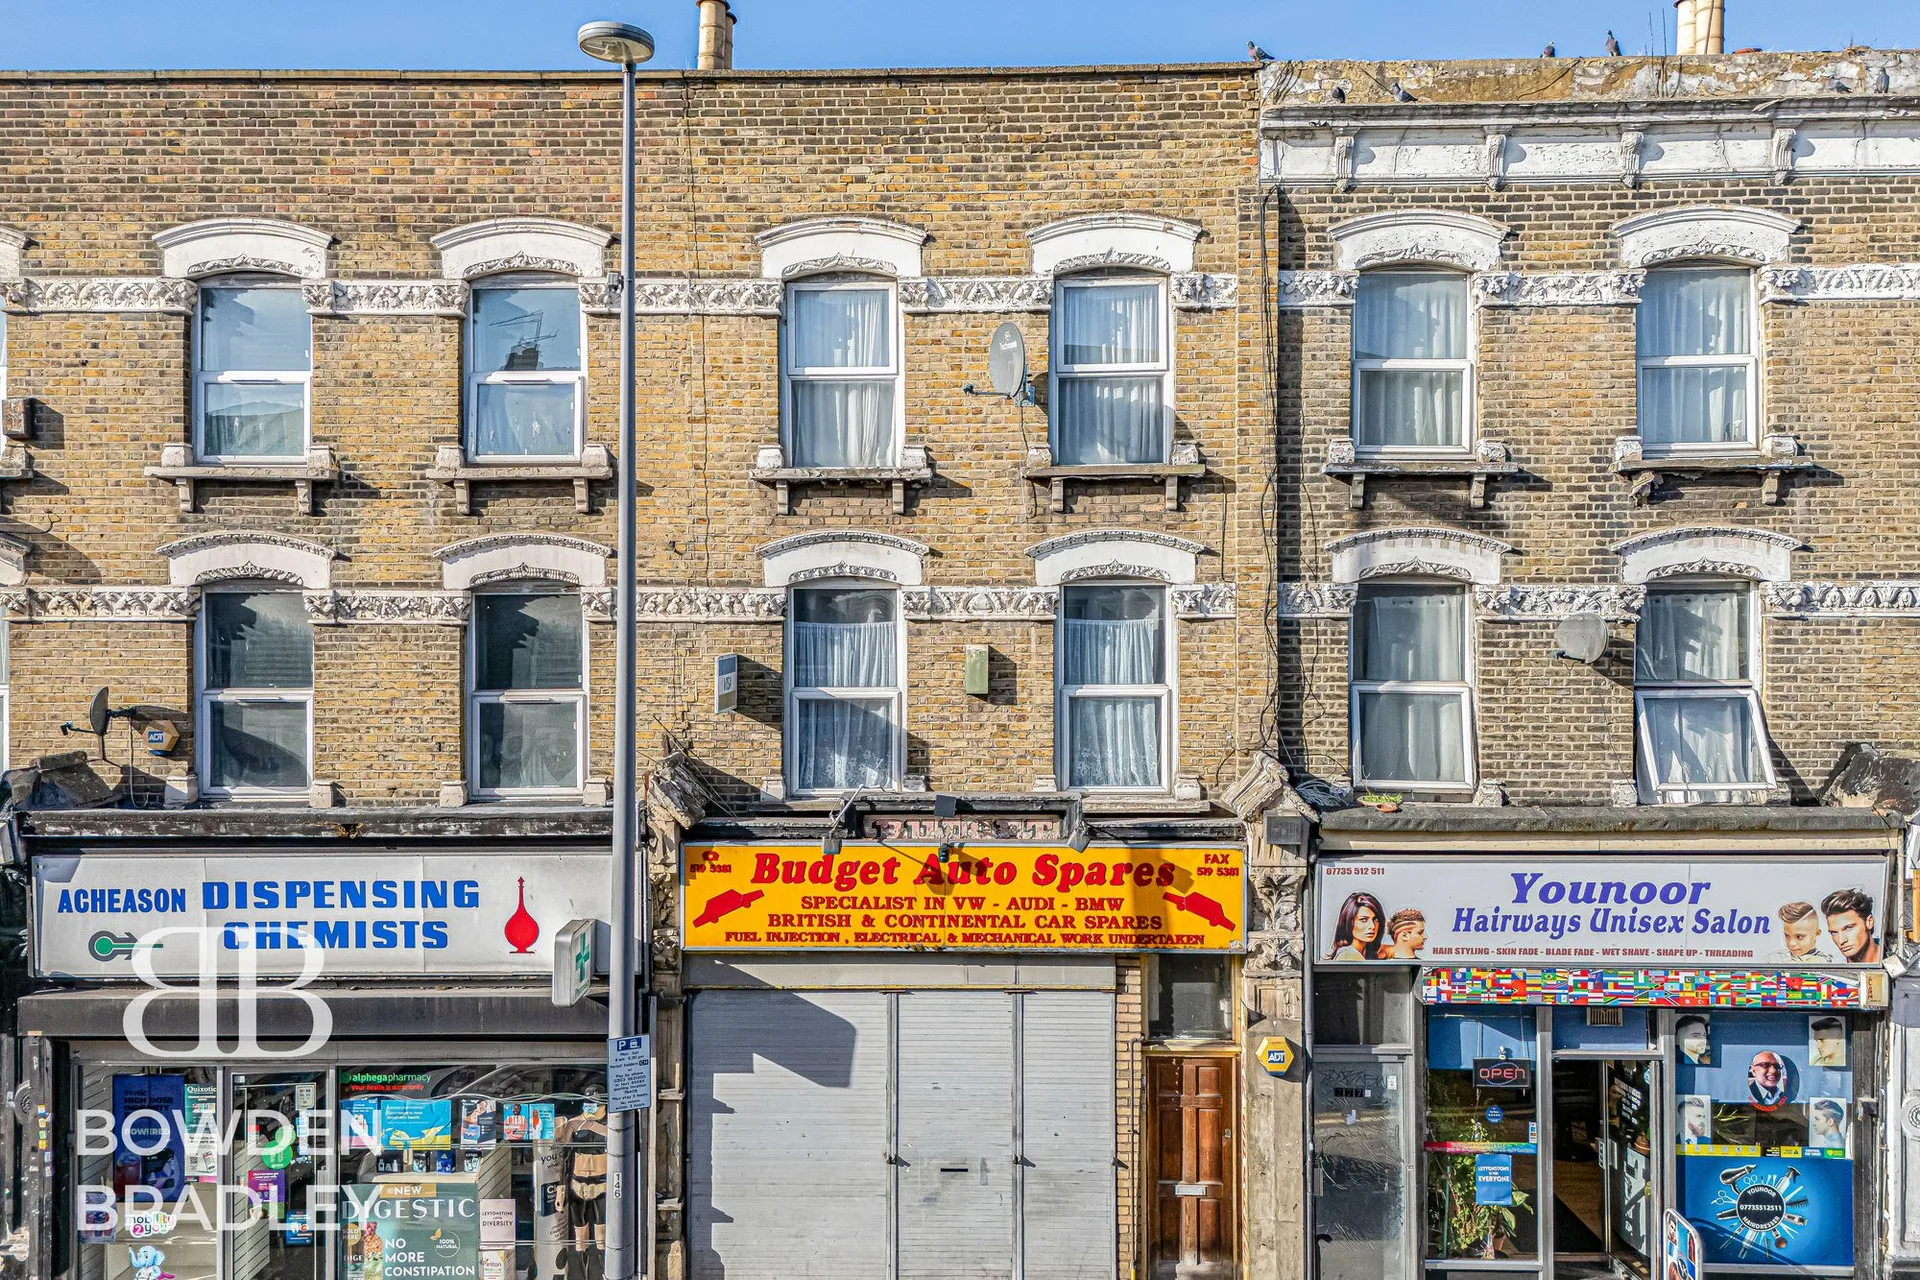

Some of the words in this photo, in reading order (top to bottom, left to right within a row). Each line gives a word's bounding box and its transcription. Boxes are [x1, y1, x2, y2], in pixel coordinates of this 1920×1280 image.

[148, 732, 164, 740] ADT
[1204, 854, 1229, 865] FAX
[751, 852, 901, 892] Budget
[913, 852, 1017, 886] Auto
[1032, 853, 1175, 893] Spares
[1196, 867, 1212, 876] 519
[1216, 867, 1239, 876] 5381
[1326, 867, 1352, 876] 07735
[1354, 868, 1369, 876] 512
[1371, 868, 1385, 876] 511
[1511, 872, 1711, 905] Younoor
[202, 880, 479, 909] DISPENSING
[57, 888, 186, 913] ACHEASON
[801, 896, 916, 910] SPECIALIST
[923, 896, 945, 910] IN
[954, 896, 986, 910] VW
[1006, 897, 1055, 911] AUDI
[1074, 897, 1124, 911] BMW
[768, 914, 851, 928] BRITISH
[861, 914, 876, 928] &
[884, 914, 1026, 929] CONTINENTAL
[1034, 915, 1075, 929] CAR
[1084, 915, 1163, 930] SPARES
[1452, 905, 1581, 940] Hairways
[1590, 908, 1684, 934] Unisex
[1691, 908, 1771, 935] Salon
[223, 921, 449, 949] CHEMISTS
[724, 932, 762, 942] FUEL
[766, 932, 840, 943] INJECTION
[854, 932, 942, 944] ELECTRICAL
[947, 933, 958, 943] &
[962, 933, 1056, 944] MECHANICAL
[1062, 934, 1104, 945] WORK
[1108, 934, 1205, 946] UNDERTAKEN
[1432, 947, 1453, 956] HAIR
[1454, 947, 1490, 956] STYLING
[1496, 948, 1517, 956] SKIN
[1518, 948, 1538, 956] FADE
[1546, 948, 1572, 956] BLADE
[1574, 948, 1594, 956] FADE
[1602, 948, 1621, 956] WET
[1623, 948, 1650, 956] SHAVE
[1656, 948, 1684, 957] SHAPE
[1686, 949, 1698, 957] UP
[1705, 949, 1754, 958] THREADING
[618, 1040, 627, 1050] P
[1268, 1052, 1285, 1062] ADT
[352, 1073, 432, 1082] alphegapharmacy
[1480, 1068, 1526, 1079] OPEN
[541, 1154, 557, 1164] you
[394, 1186, 422, 1195] NEW
[1746, 1186, 1776, 1197] YOUNOOR
[1742, 1216, 1780, 1230] HAIRDRESSER
[385, 1239, 406, 1249] NO
[385, 1252, 424, 1262] MORE
[385, 1266, 475, 1277] CONSTIPATION
